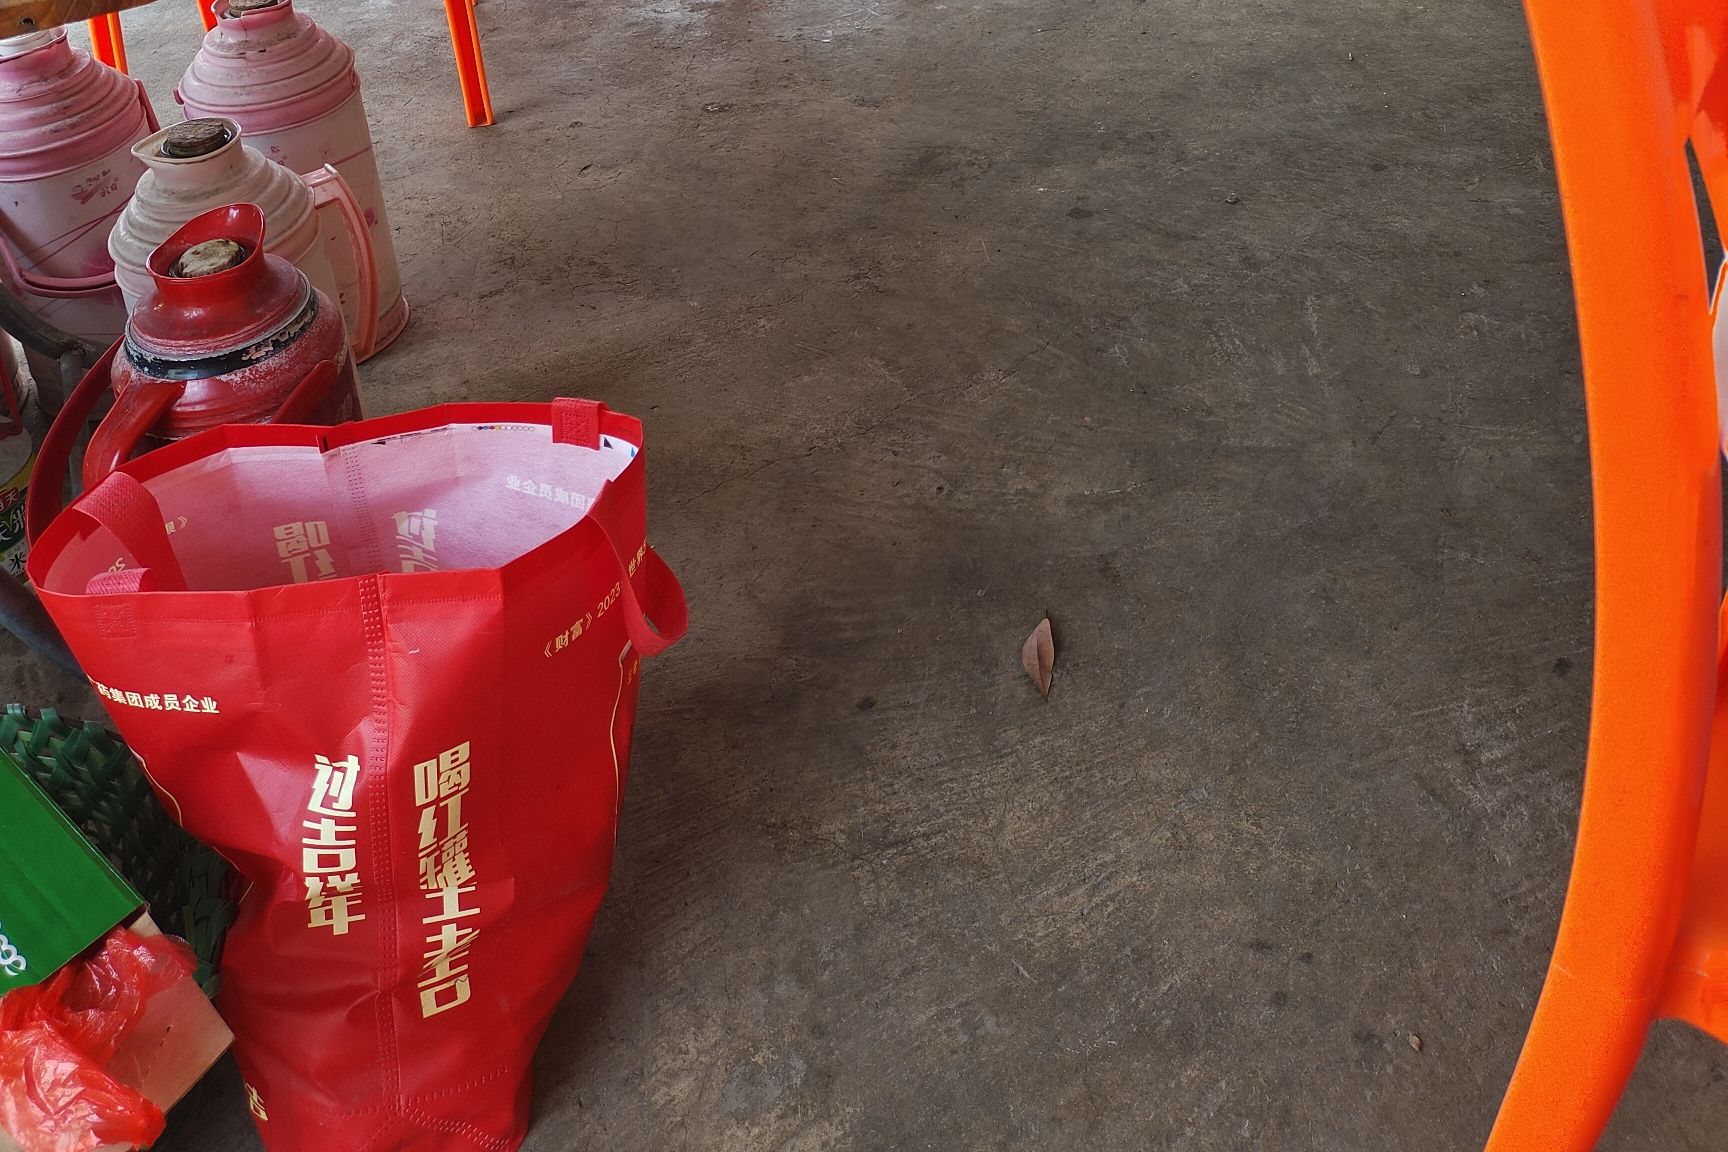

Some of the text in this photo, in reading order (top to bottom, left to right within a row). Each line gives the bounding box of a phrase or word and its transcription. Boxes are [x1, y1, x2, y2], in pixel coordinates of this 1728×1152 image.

[302, 753, 366, 936] 过吉祥年
[413, 740, 481, 1019] 喝红罐王老吉
